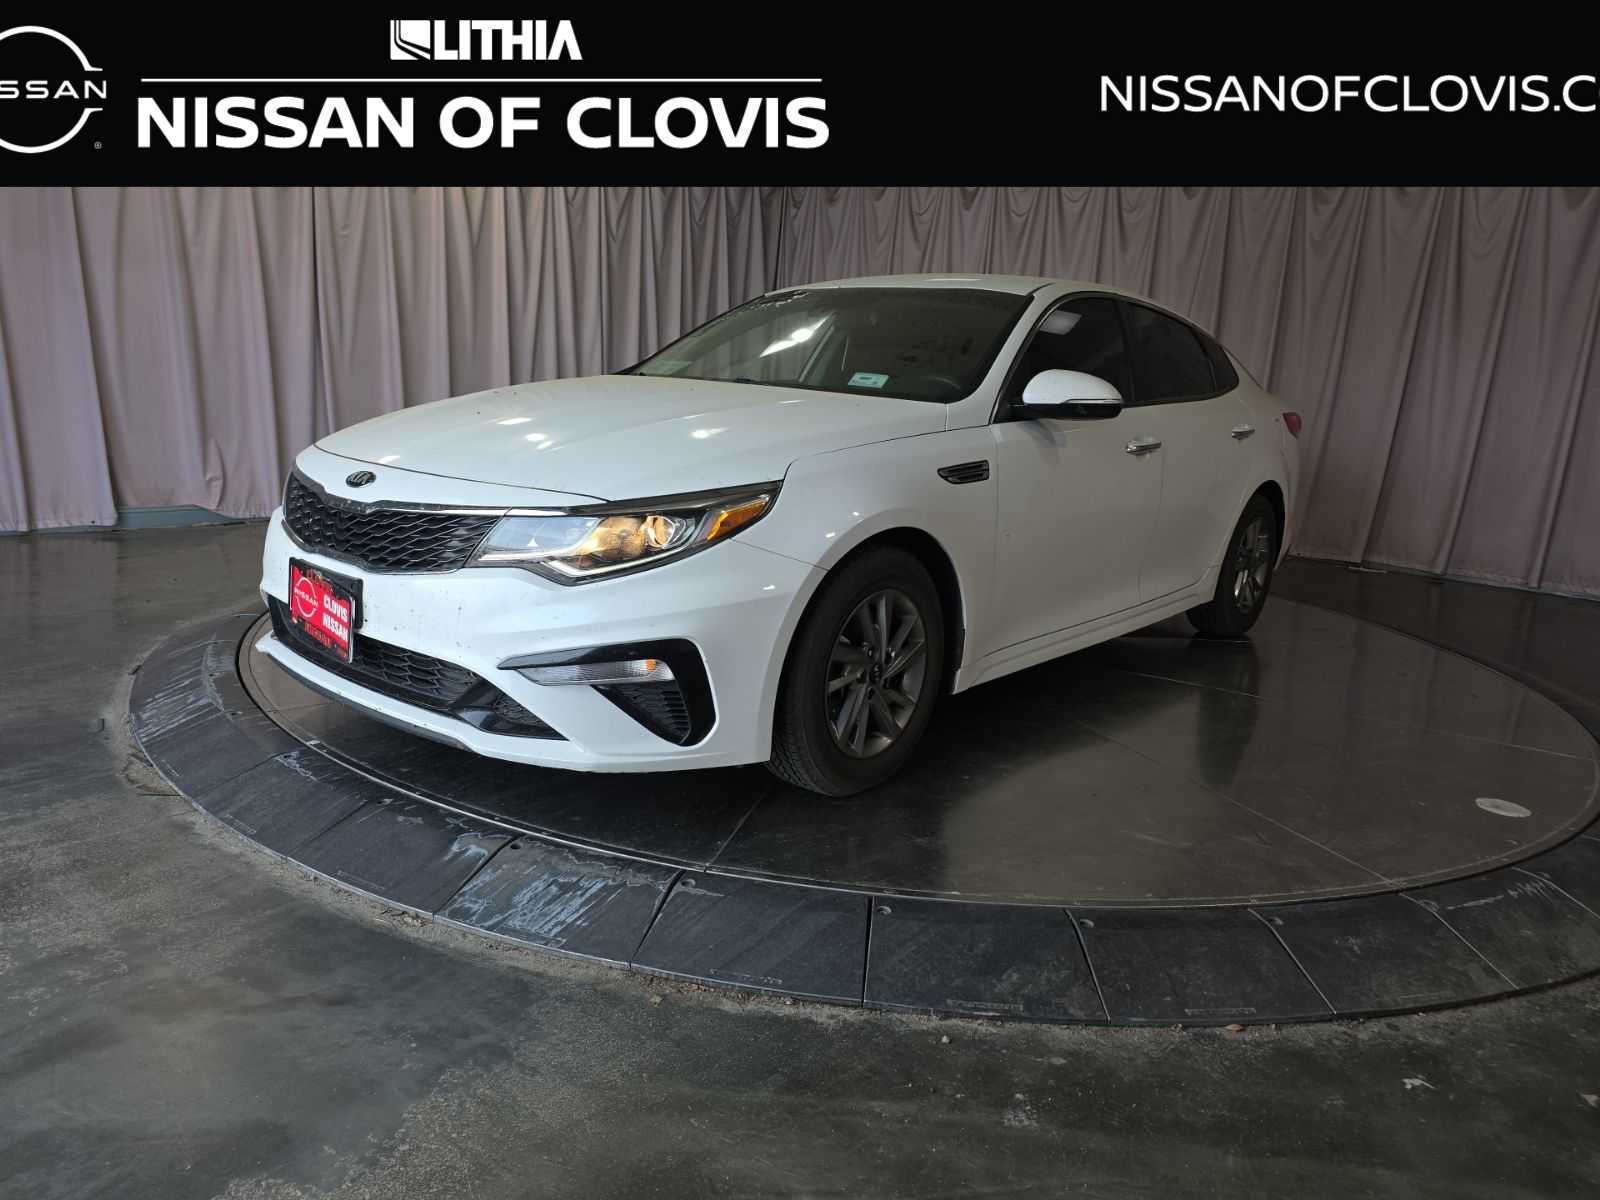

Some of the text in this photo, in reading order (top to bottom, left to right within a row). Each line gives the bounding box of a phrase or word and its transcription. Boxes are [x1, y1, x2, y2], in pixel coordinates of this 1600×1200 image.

[294, 587, 319, 608] NISSAN
[323, 594, 348, 622] CLOVIS
[322, 613, 348, 642] NISSAN
